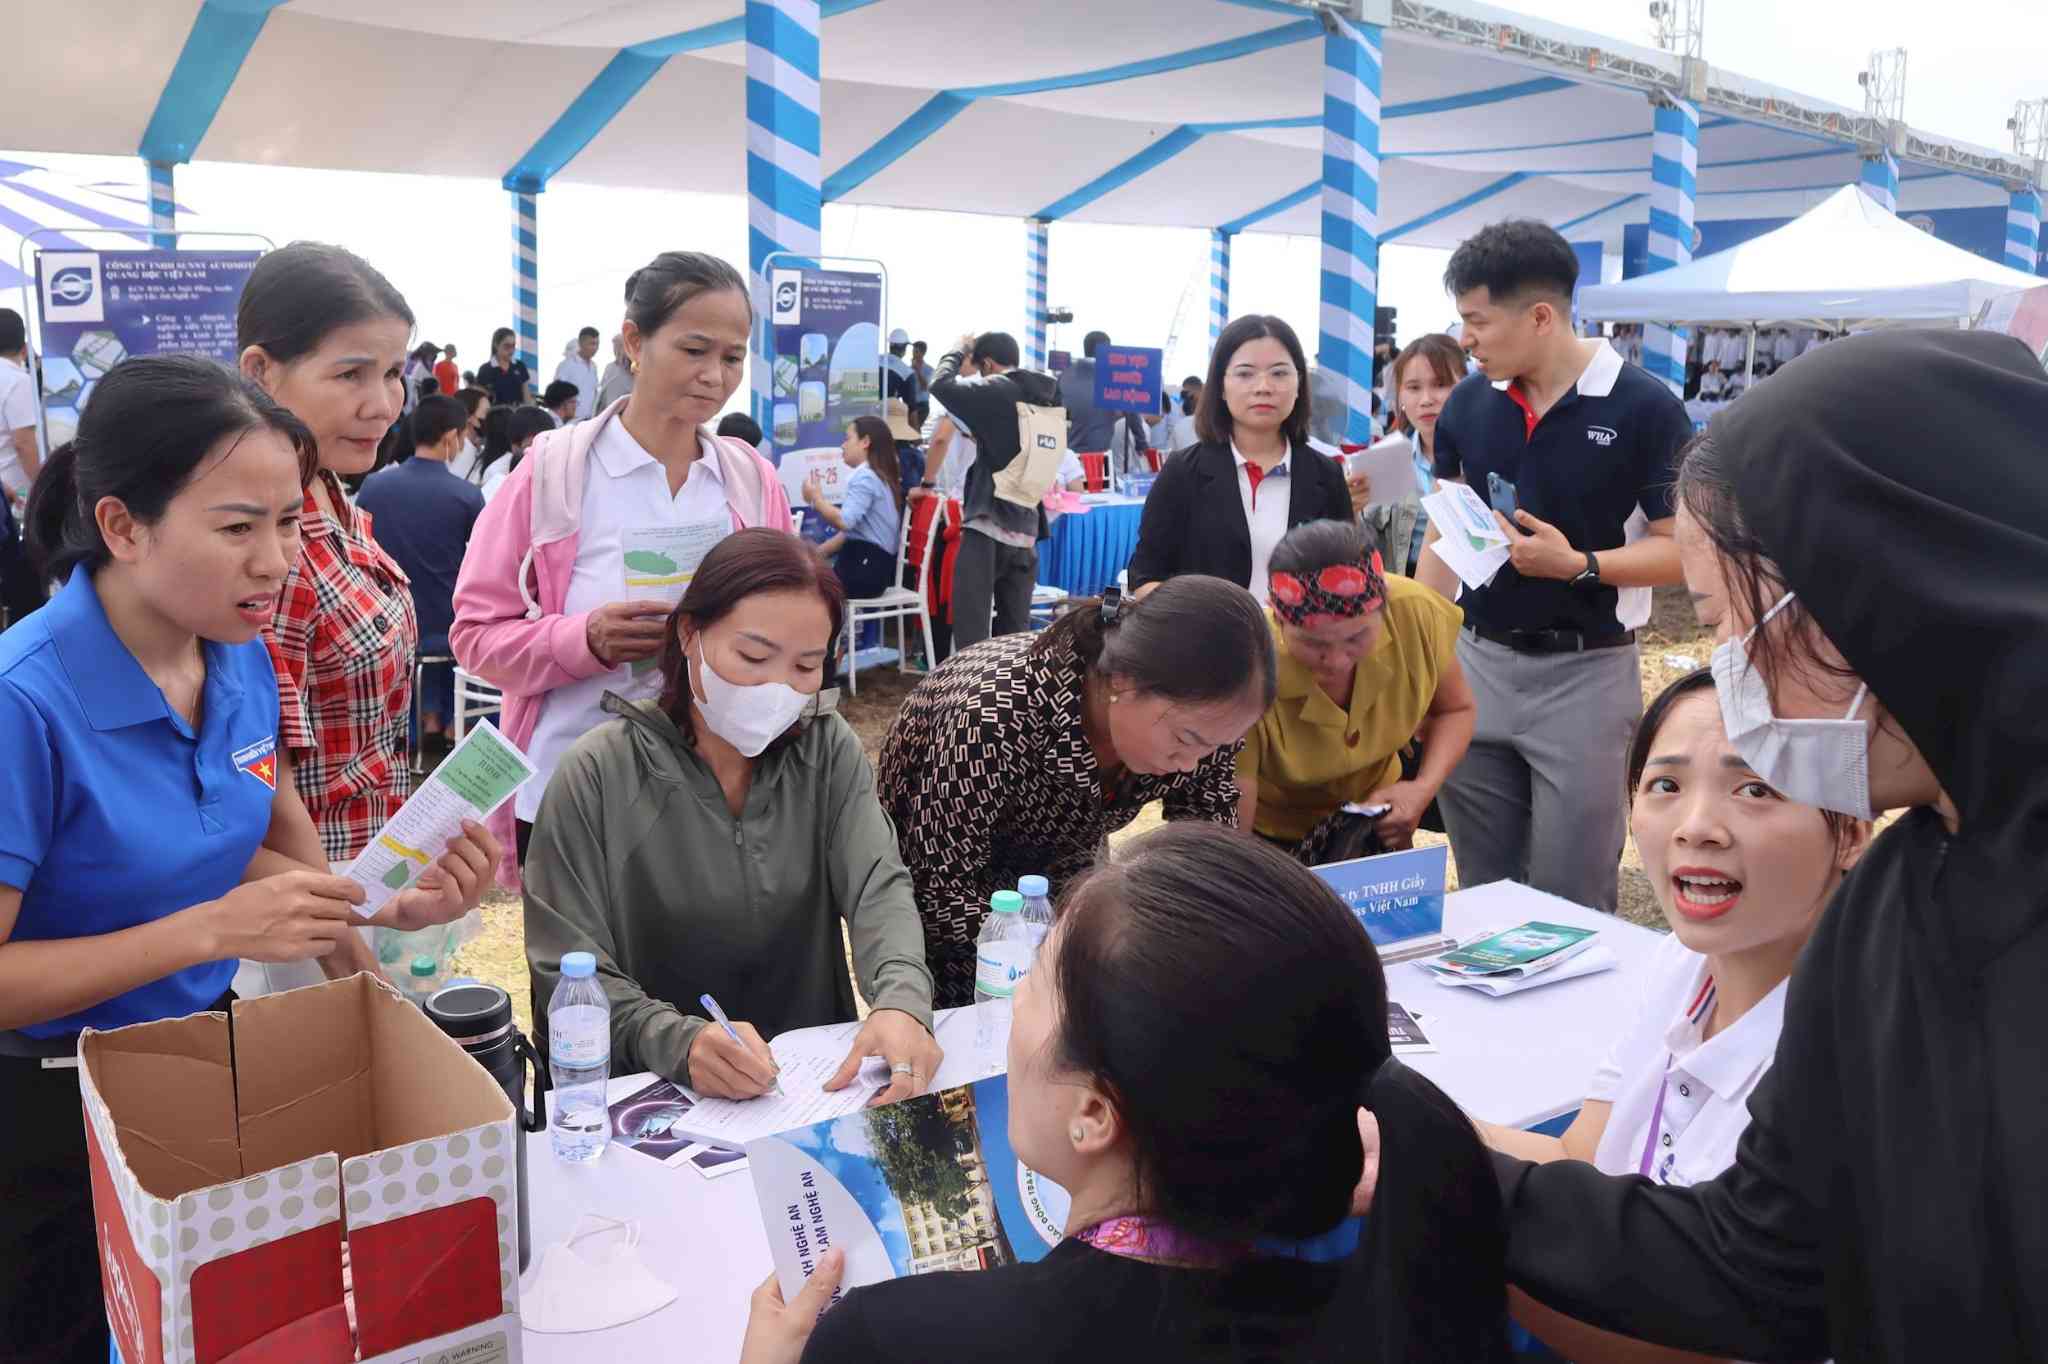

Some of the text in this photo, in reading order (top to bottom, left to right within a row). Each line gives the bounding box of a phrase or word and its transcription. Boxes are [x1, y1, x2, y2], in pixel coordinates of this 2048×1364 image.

[1587, 430, 1611, 441] WHA
[1361, 880, 1398, 898] TNHH
[1369, 898, 1391, 914] Việt
[1393, 896, 1418, 909] Nam
[800, 1170, 816, 1188] AN
[787, 1203, 801, 1221] AN
[802, 1189, 824, 1225] NGHỆ
[789, 1223, 812, 1258] NGHỆ
[452, 1342, 496, 1360] WARNING
